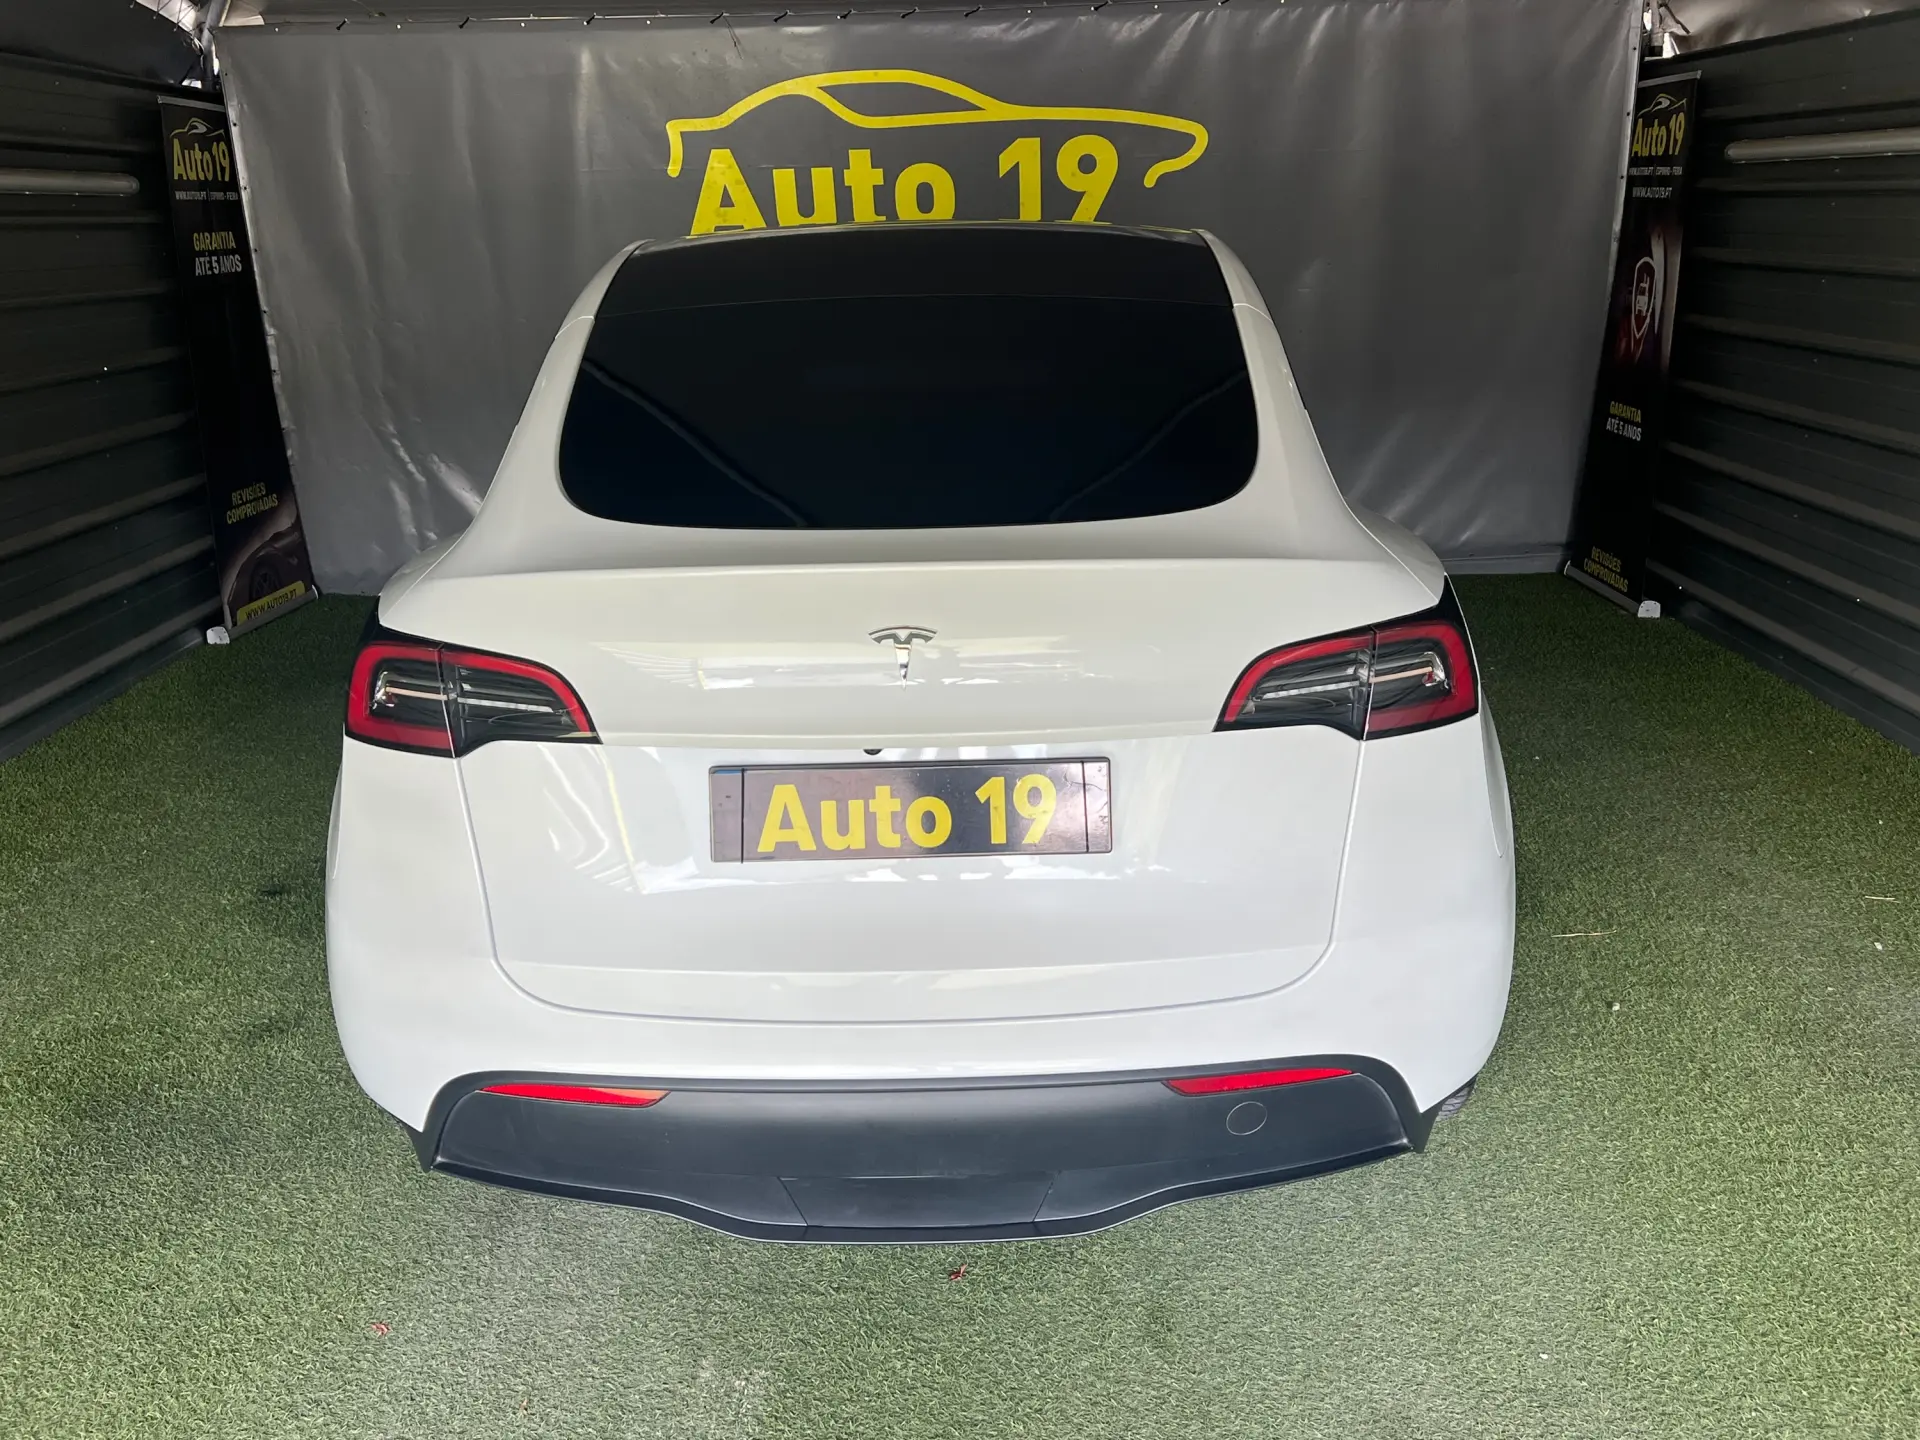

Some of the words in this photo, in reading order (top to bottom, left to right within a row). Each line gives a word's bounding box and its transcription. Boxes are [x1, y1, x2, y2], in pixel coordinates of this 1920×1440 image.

[1631, 118, 1667, 157] Auto
[1668, 112, 1685, 156] 19
[173, 138, 213, 181] Auto
[212, 141, 230, 182] 19
[689, 148, 956, 236] Auto
[998, 134, 1119, 222] 19
[193, 231, 236, 251] GARANTIA
[195, 252, 212, 276] ATÉ
[212, 256, 219, 274] 5
[219, 254, 242, 273] ANOS
[1609, 401, 1642, 423] GARANTIA
[1619, 421, 1624, 435] 5
[1623, 423, 1642, 441] ANOS
[226, 493, 278, 524] COMPROVADAS
[756, 783, 953, 853] Auto
[974, 773, 1058, 845] 19
